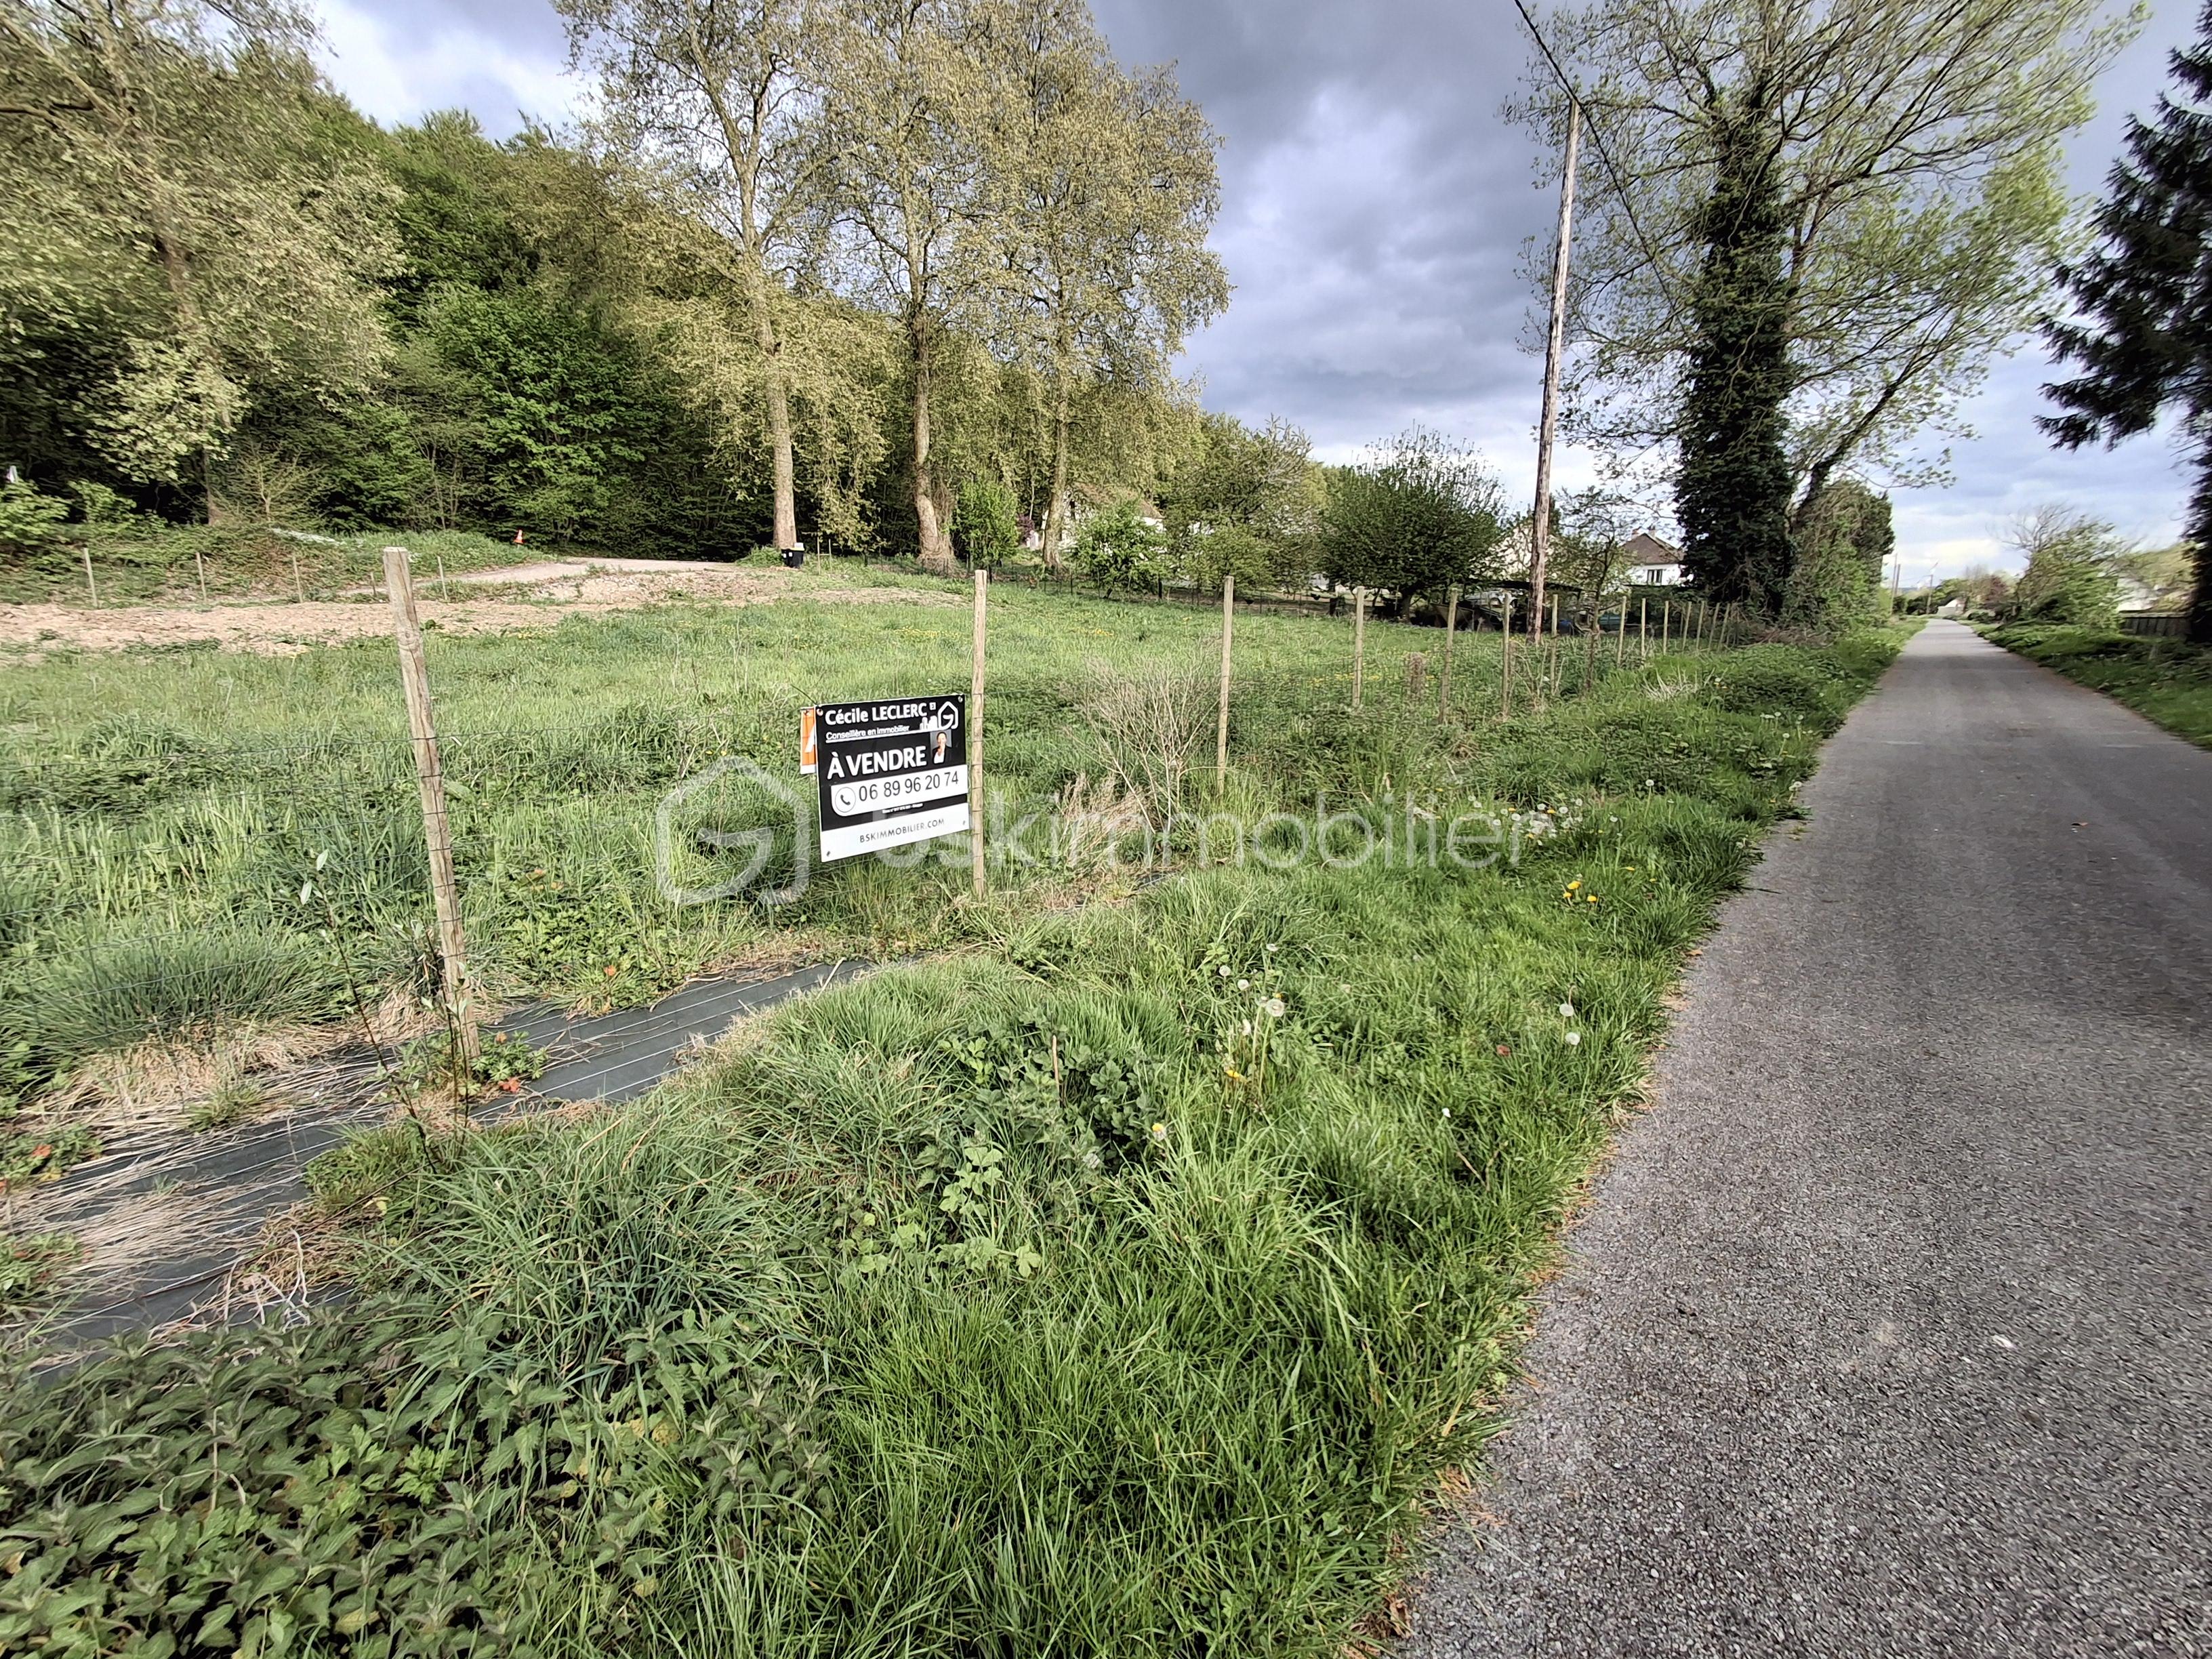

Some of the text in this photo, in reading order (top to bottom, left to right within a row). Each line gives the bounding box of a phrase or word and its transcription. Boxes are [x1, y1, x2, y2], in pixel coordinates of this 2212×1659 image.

[825, 707, 869, 725] Cécile
[872, 702, 928, 722] LECLERC
[825, 729, 866, 740] Conseillère
[827, 745, 927, 779] À VENDRE
[859, 771, 959, 802] 06 89 96 20 74
[859, 818, 945, 843] BSKIMMOBILIER.COM
